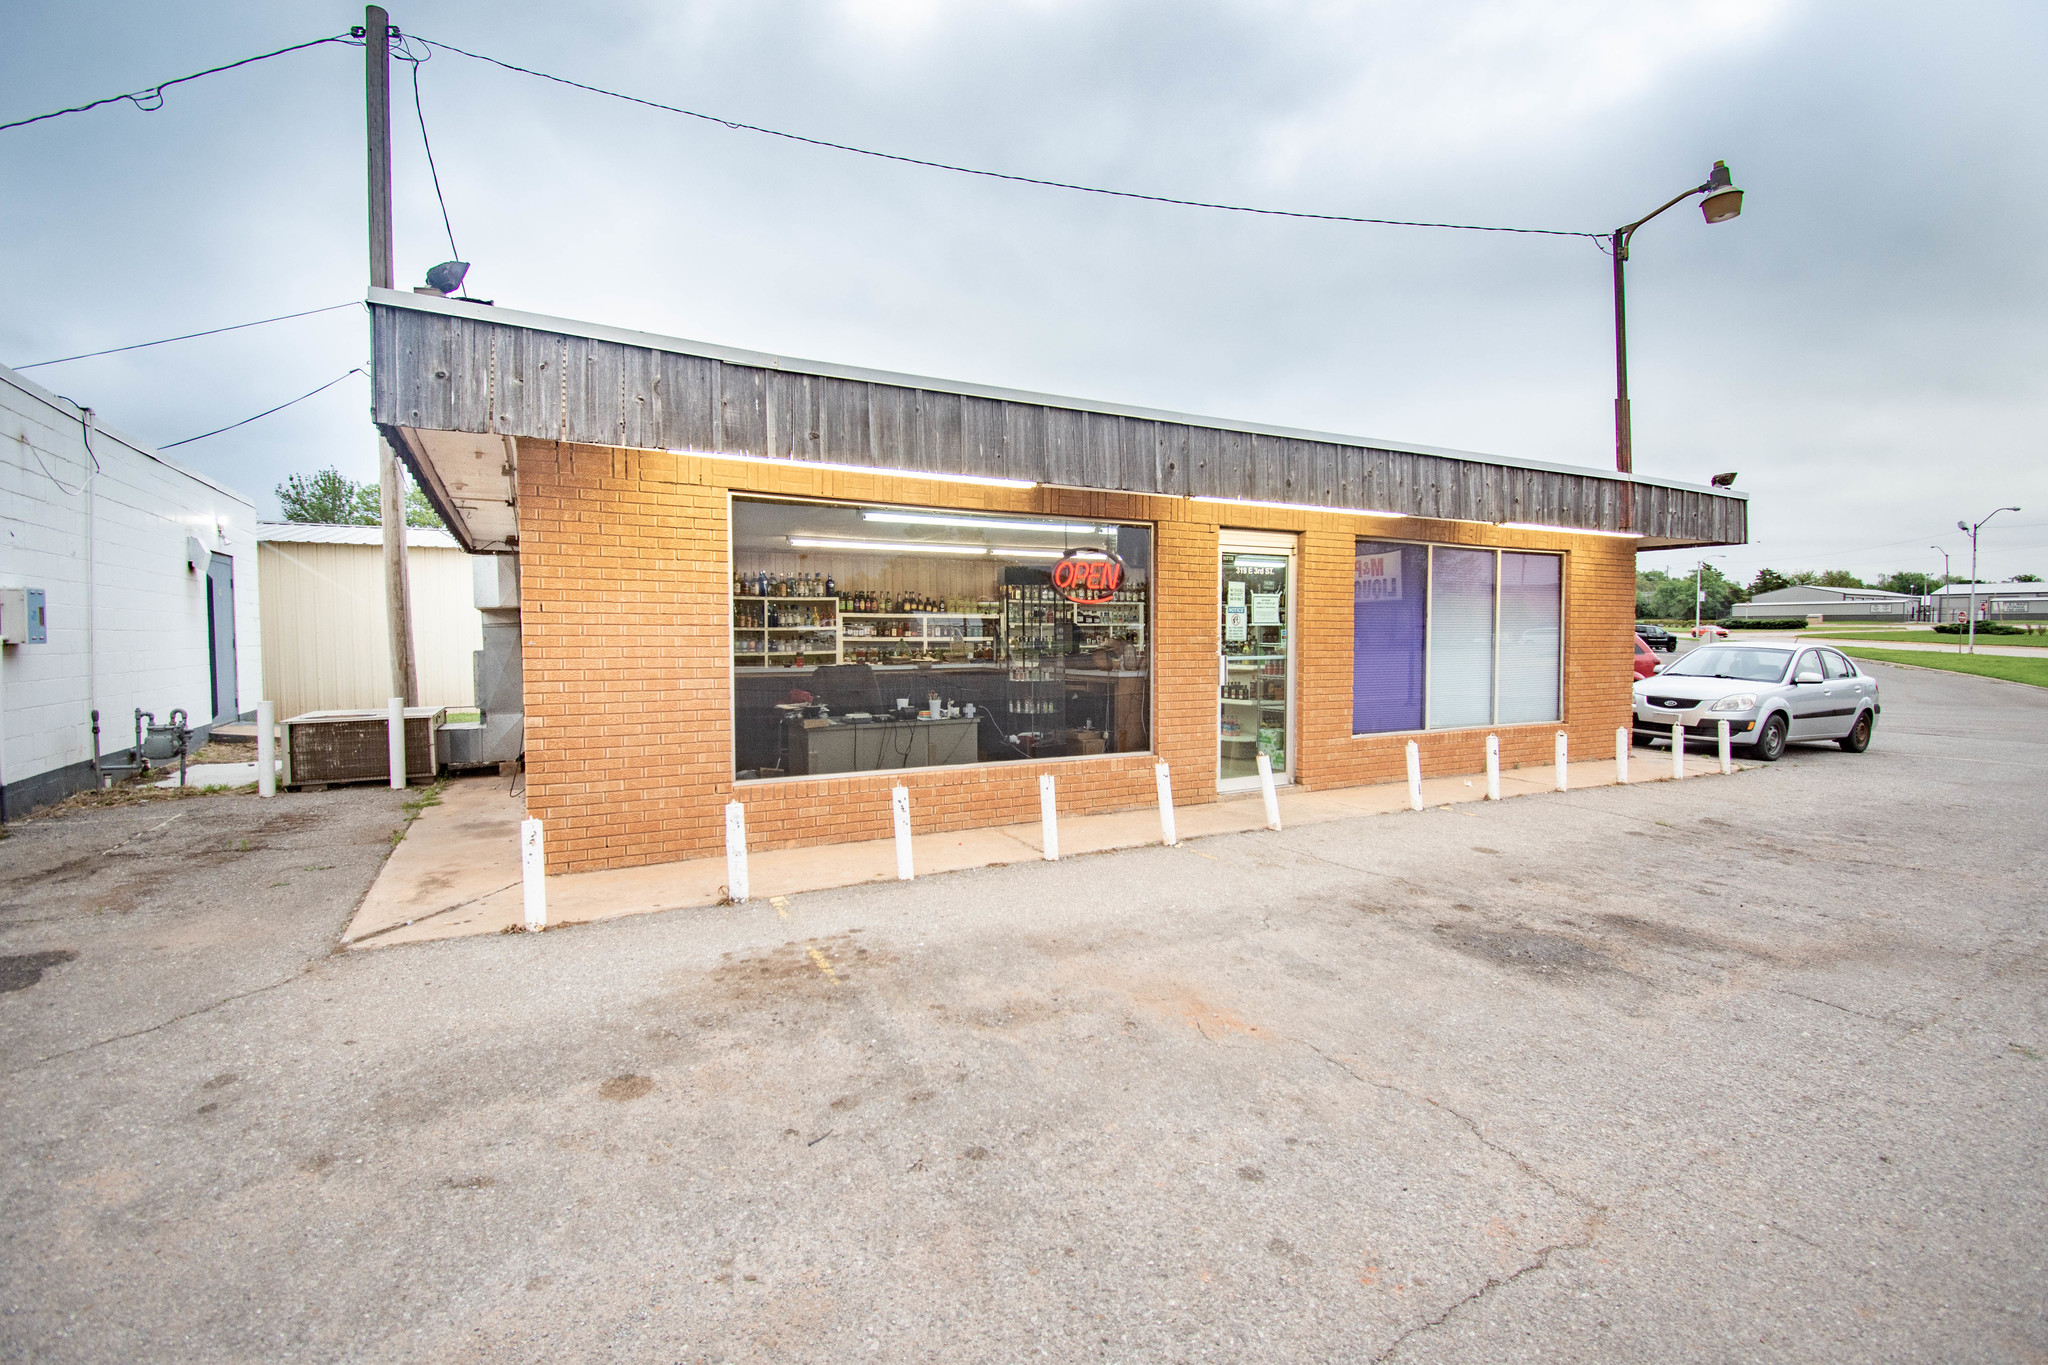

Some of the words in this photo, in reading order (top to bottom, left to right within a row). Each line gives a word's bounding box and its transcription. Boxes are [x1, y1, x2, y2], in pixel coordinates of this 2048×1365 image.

[1055, 561, 1120, 589] OPEN
[1235, 566, 1247, 574] 319
[1253, 567, 1264, 575] 3rd
